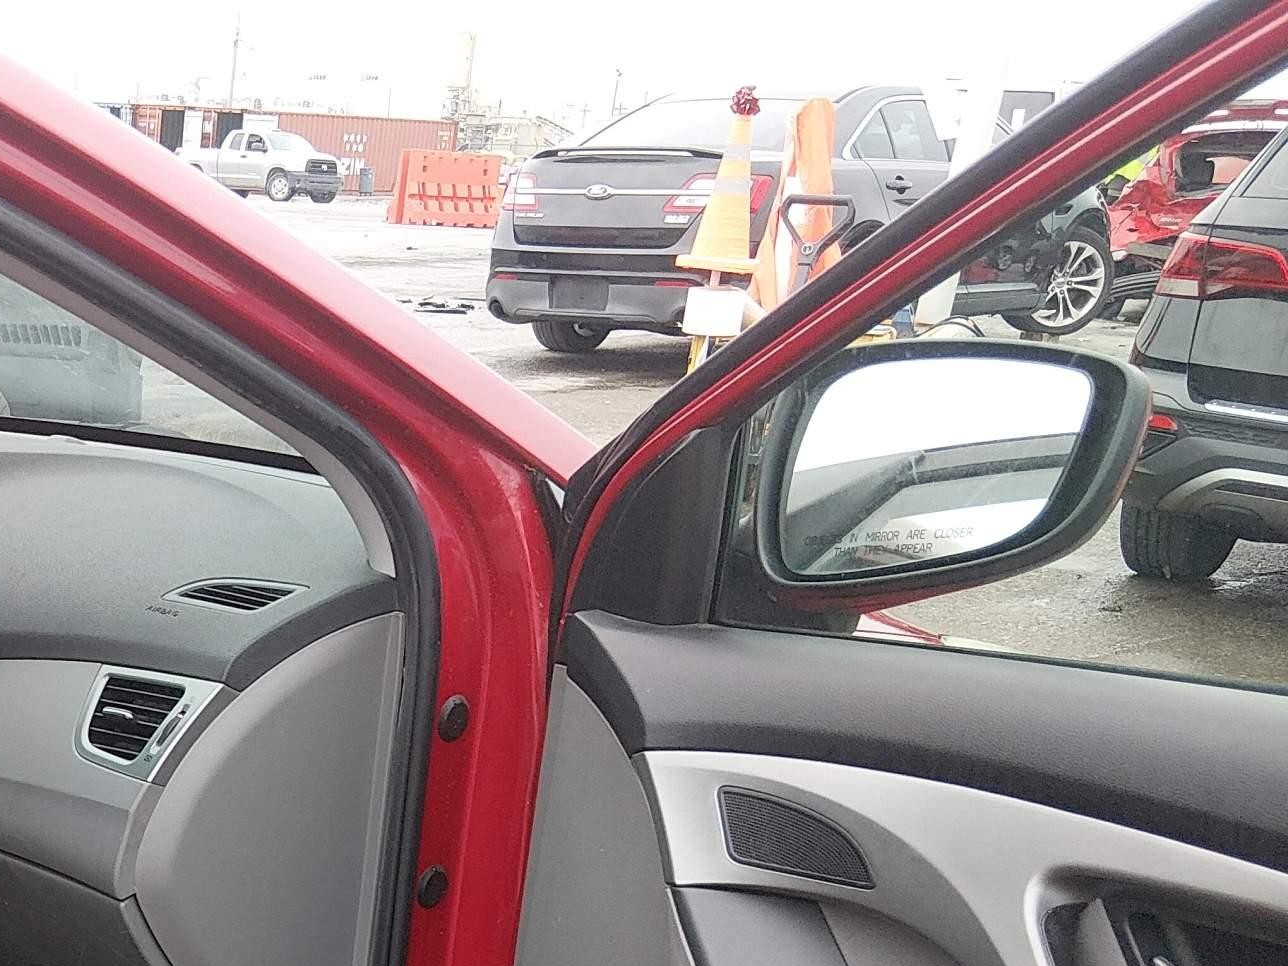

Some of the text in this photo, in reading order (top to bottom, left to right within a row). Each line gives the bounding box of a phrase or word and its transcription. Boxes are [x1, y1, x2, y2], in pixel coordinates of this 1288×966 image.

[865, 530, 900, 542] MIRROR
[906, 528, 927, 540] ARE
[934, 527, 974, 539] CLOSER
[894, 542, 934, 554] APPEAR
[146, 605, 180, 617] AIRBAG
